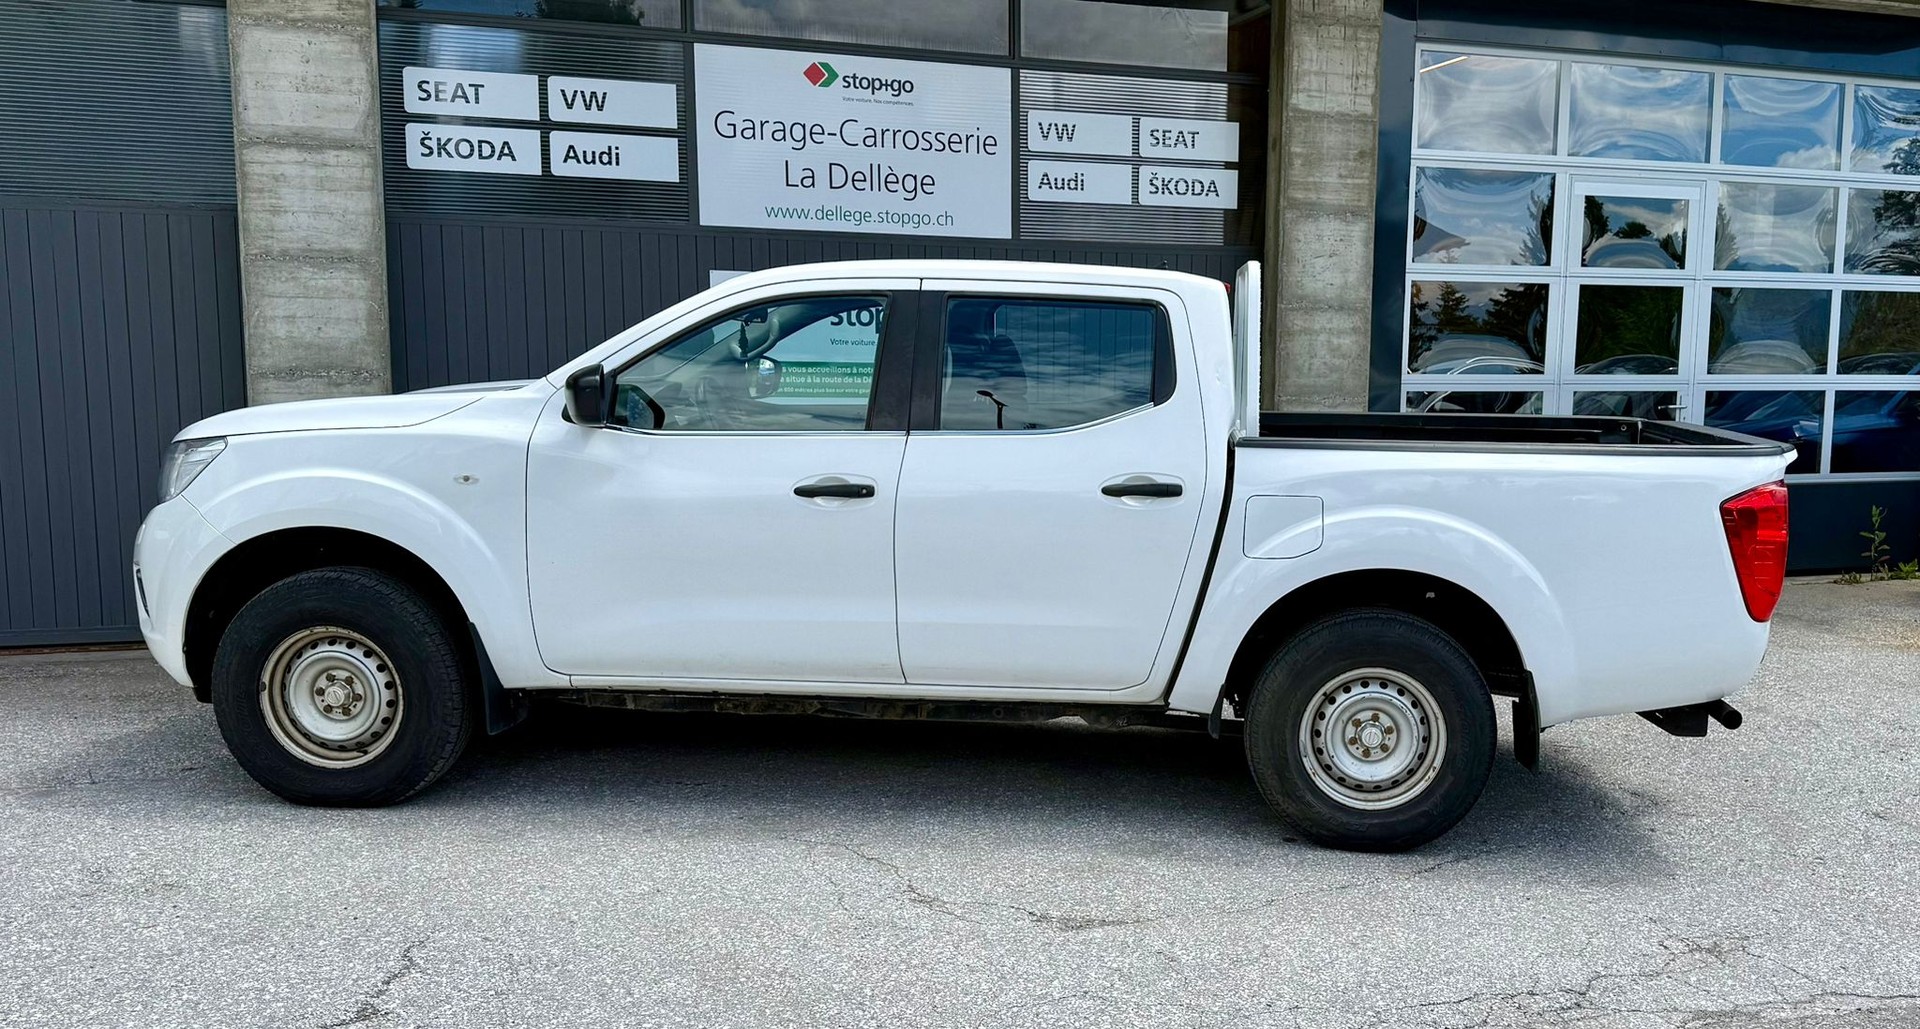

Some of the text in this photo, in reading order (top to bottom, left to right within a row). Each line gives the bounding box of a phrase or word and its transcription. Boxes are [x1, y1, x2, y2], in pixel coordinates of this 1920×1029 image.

[417, 80, 484, 105] SEAT
[842, 73, 914, 97] stop+go
[560, 88, 607, 112] VW
[714, 110, 998, 156] Garage-Carrosserie
[1038, 121, 1076, 143] VW
[1149, 129, 1200, 150] SEAT
[419, 131, 517, 162] ŠKODA
[562, 144, 620, 167] Audi
[785, 160, 936, 201] La Dellège
[1038, 172, 1085, 192] Audi
[1148, 172, 1220, 198] ŠKODA
[764, 205, 954, 229] www.dellege.stopgo.ch
[830, 338, 849, 346] Votre
[807, 366, 851, 374] accueillons
[813, 375, 821, 383] la
[843, 375, 854, 383] de
[854, 375, 862, 383] la
